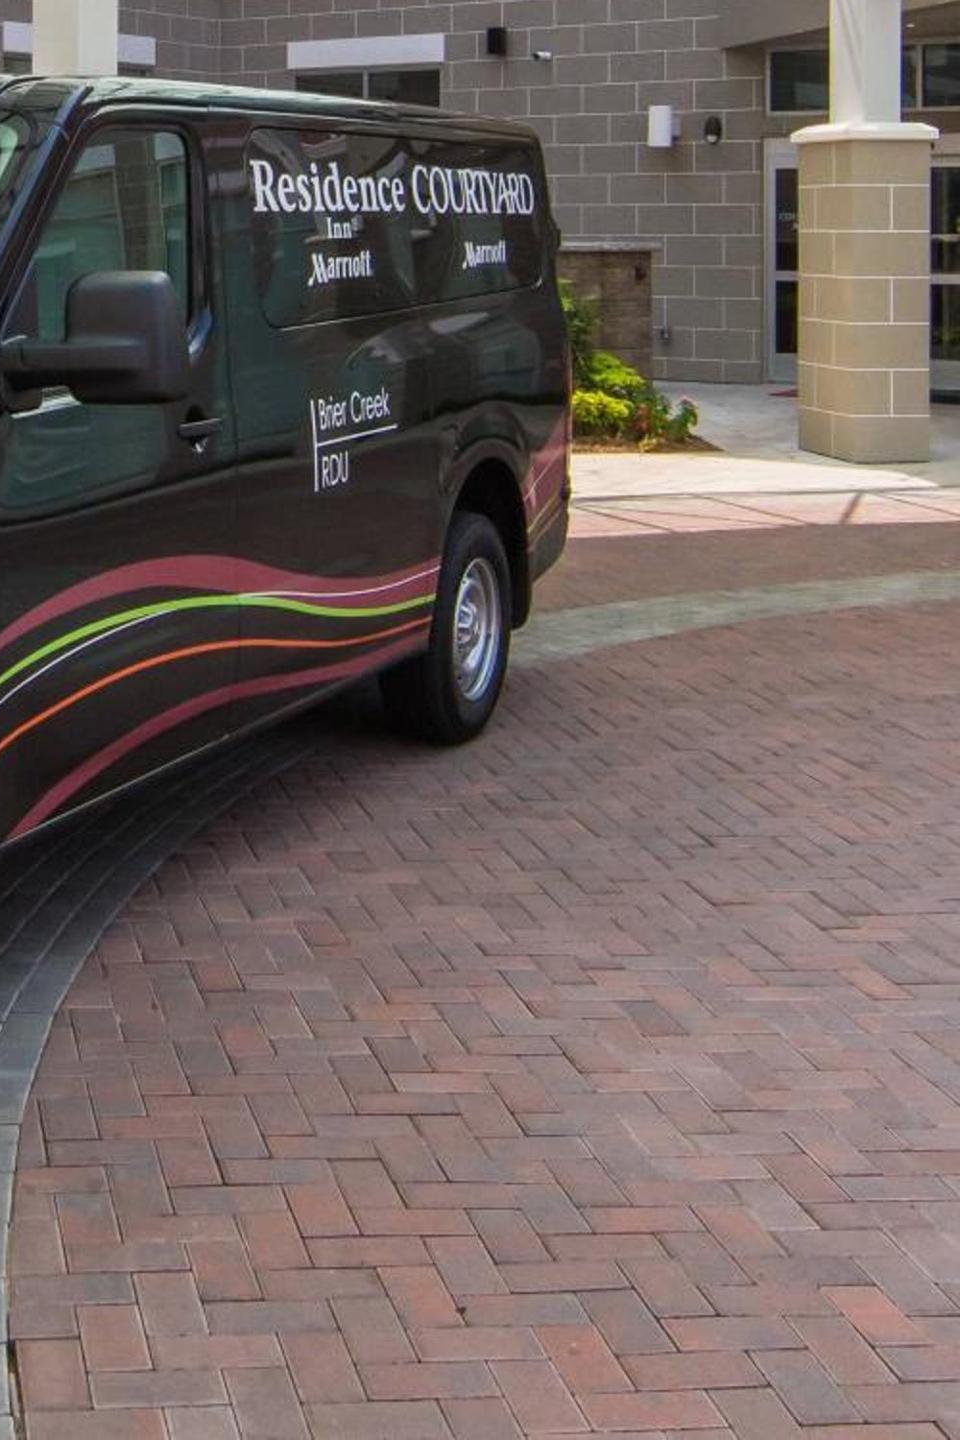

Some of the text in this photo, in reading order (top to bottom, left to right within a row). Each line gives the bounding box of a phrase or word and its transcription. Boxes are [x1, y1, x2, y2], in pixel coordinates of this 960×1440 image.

[249, 159, 406, 212] Residence
[411, 165, 535, 215] COURTYARD
[326, 217, 352, 238] Inn
[307, 249, 374, 286] Marriott
[318, 387, 391, 431] Brier Creek
[321, 450, 349, 488] RDU
